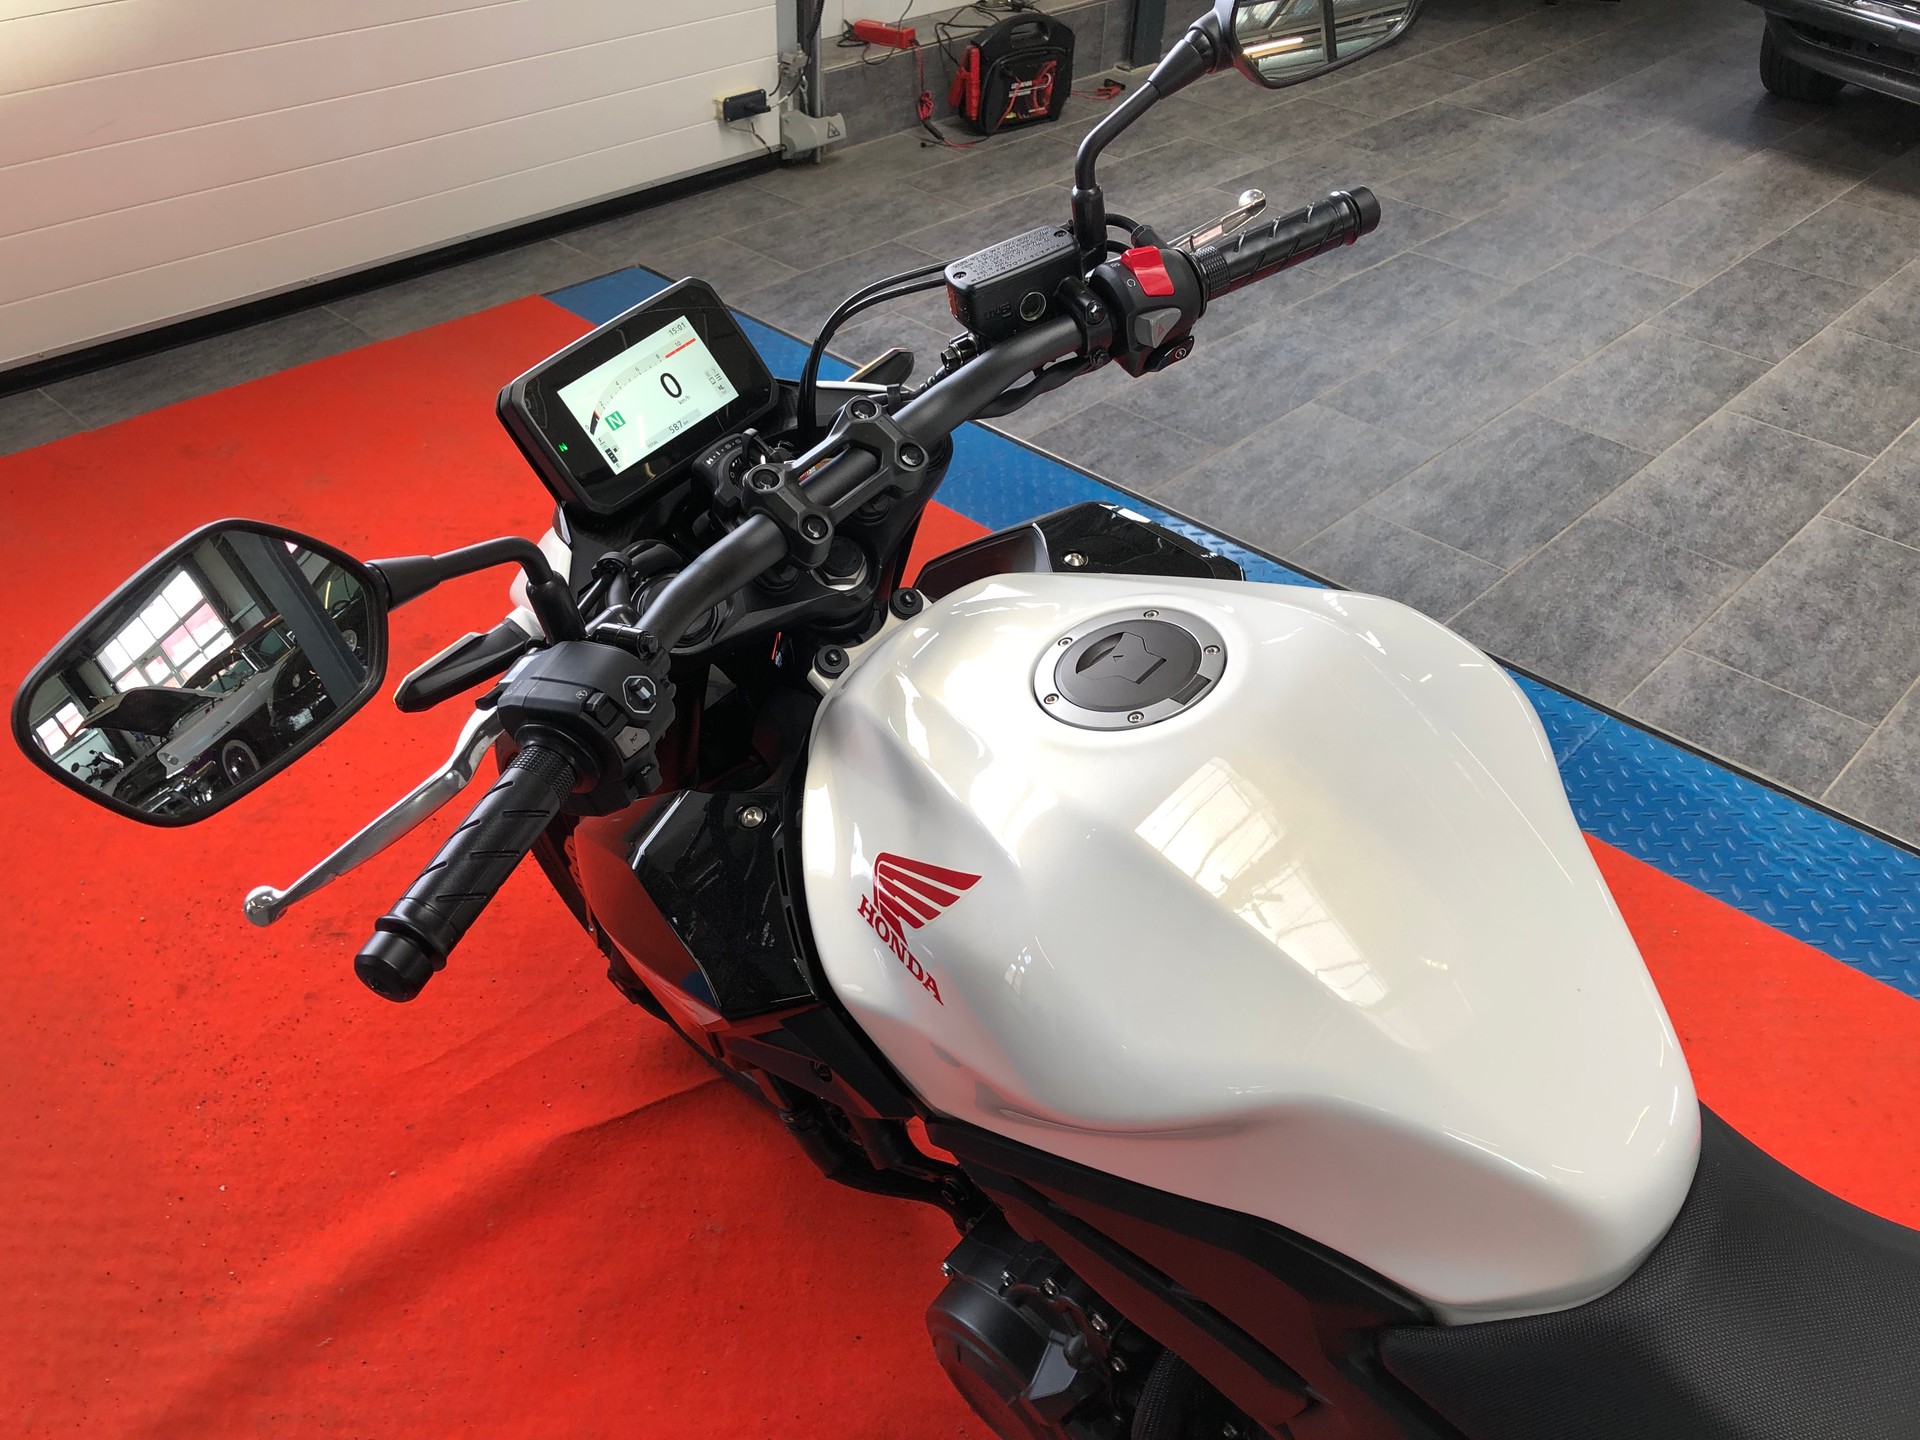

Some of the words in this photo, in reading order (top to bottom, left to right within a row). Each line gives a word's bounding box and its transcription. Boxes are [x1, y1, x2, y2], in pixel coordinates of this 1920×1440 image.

[669, 322, 686, 336] 15:01
[660, 372, 683, 399] 0
[607, 412, 624, 429] N
[668, 420, 684, 434] 587
[857, 893, 944, 1006] HONDA
